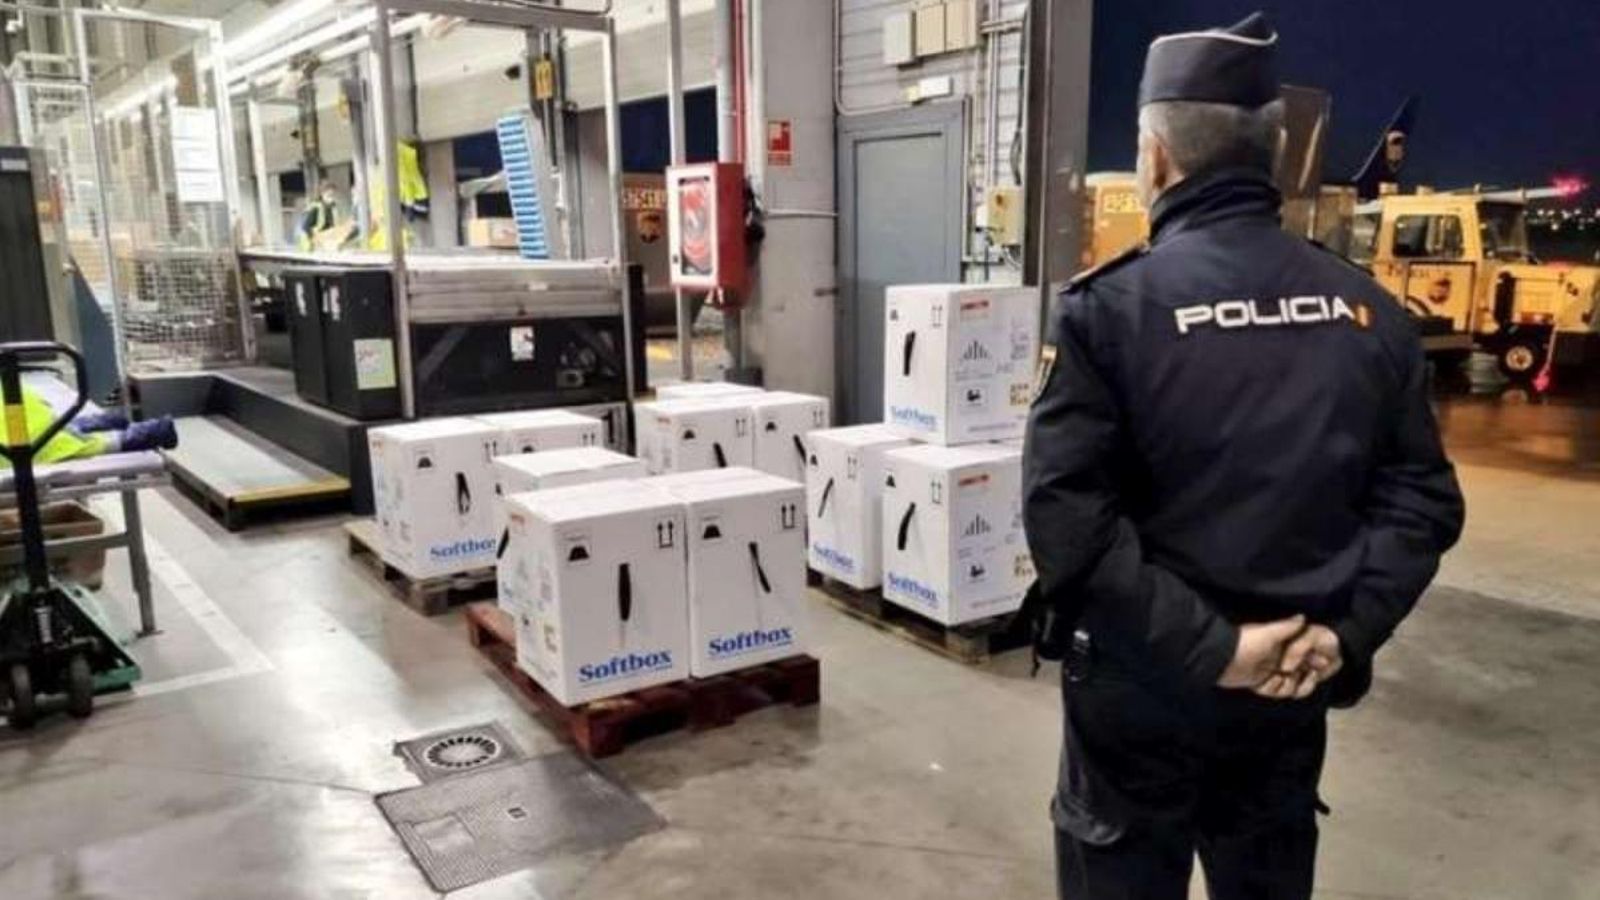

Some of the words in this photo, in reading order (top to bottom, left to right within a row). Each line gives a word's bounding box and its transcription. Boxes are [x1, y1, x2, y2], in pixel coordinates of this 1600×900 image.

[1174, 296, 1355, 334] POLICIA
[708, 626, 793, 655] Softbox
[578, 651, 672, 682] Softbox
